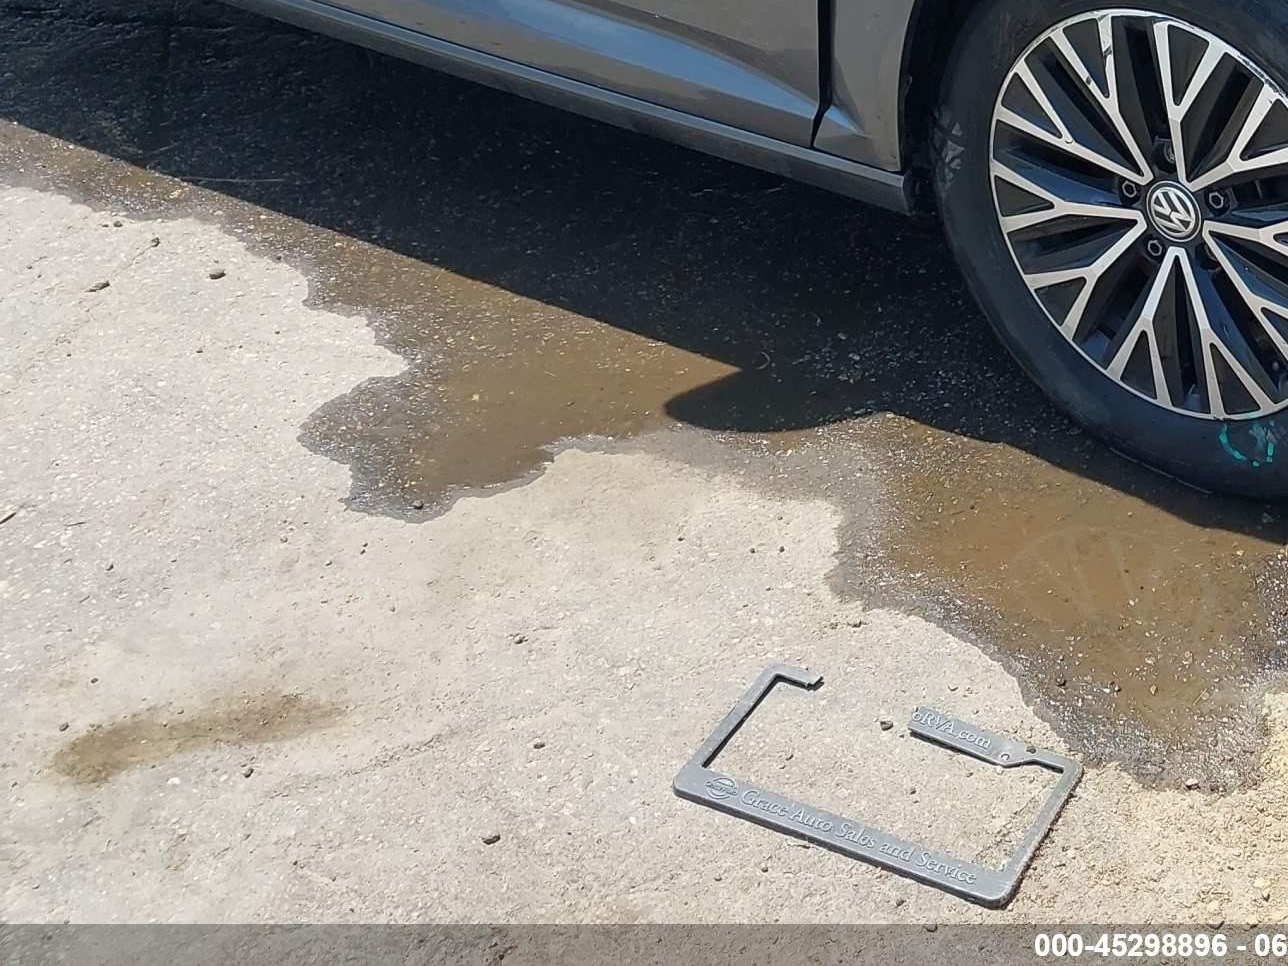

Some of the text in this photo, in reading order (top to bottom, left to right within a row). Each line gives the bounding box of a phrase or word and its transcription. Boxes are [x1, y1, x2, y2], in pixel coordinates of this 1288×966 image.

[742, 789, 788, 816] Grace
[791, 808, 834, 832] Auto
[835, 822, 878, 849] Sales
[880, 842, 917, 863] and
[916, 852, 977, 884] Service
